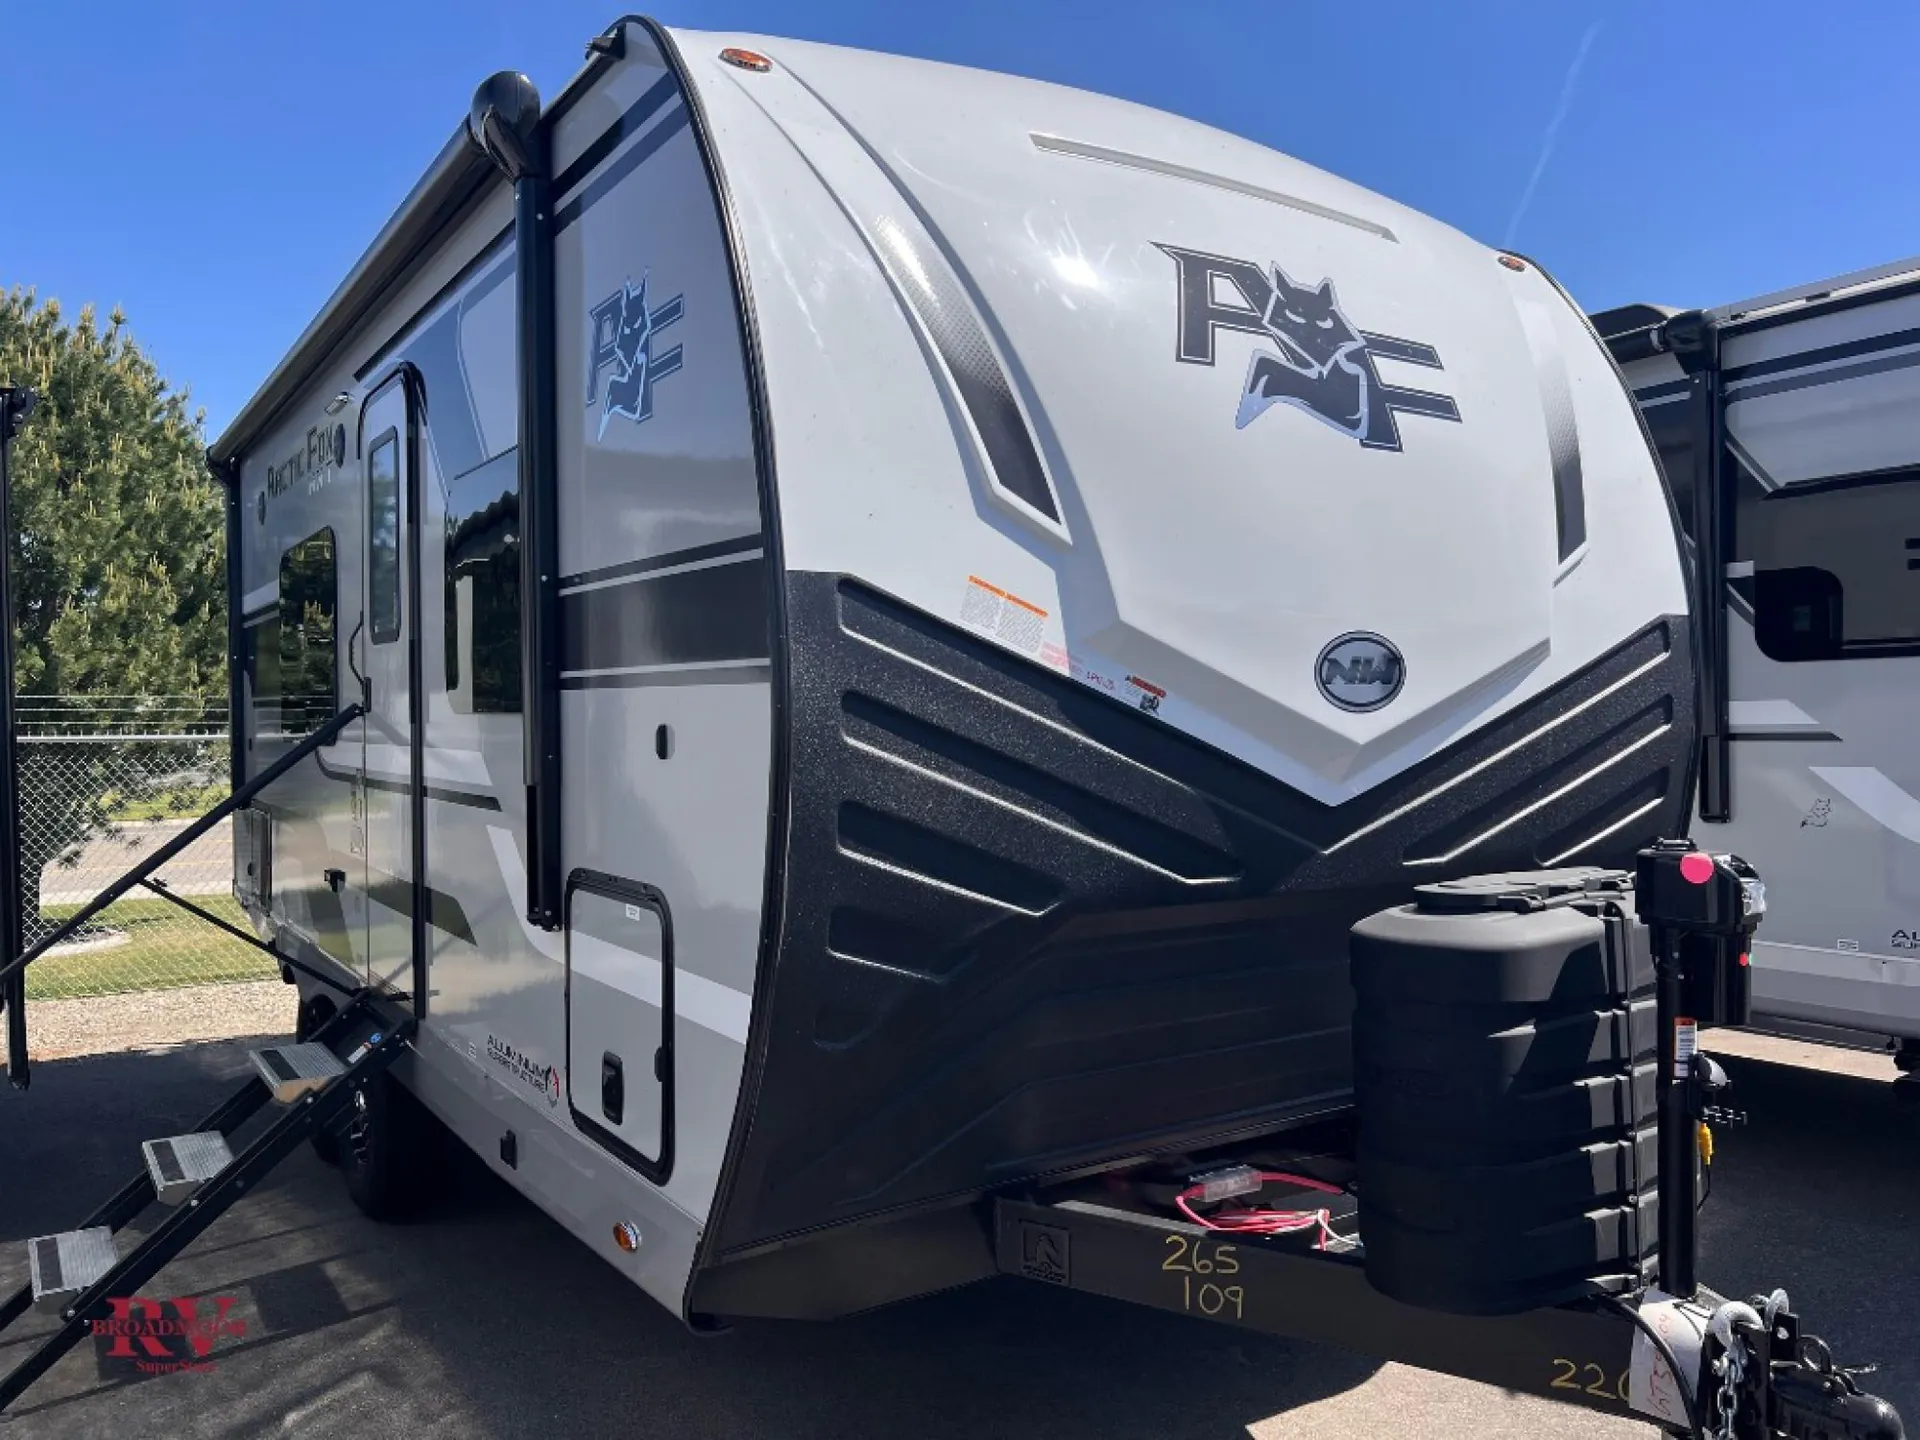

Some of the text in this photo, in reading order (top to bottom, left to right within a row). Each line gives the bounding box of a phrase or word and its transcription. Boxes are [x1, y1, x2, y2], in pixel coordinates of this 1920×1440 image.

[486, 1033, 547, 1078] ALUMINUM
[1161, 1235, 1240, 1273] 265
[1183, 1275, 1244, 1320] 109
